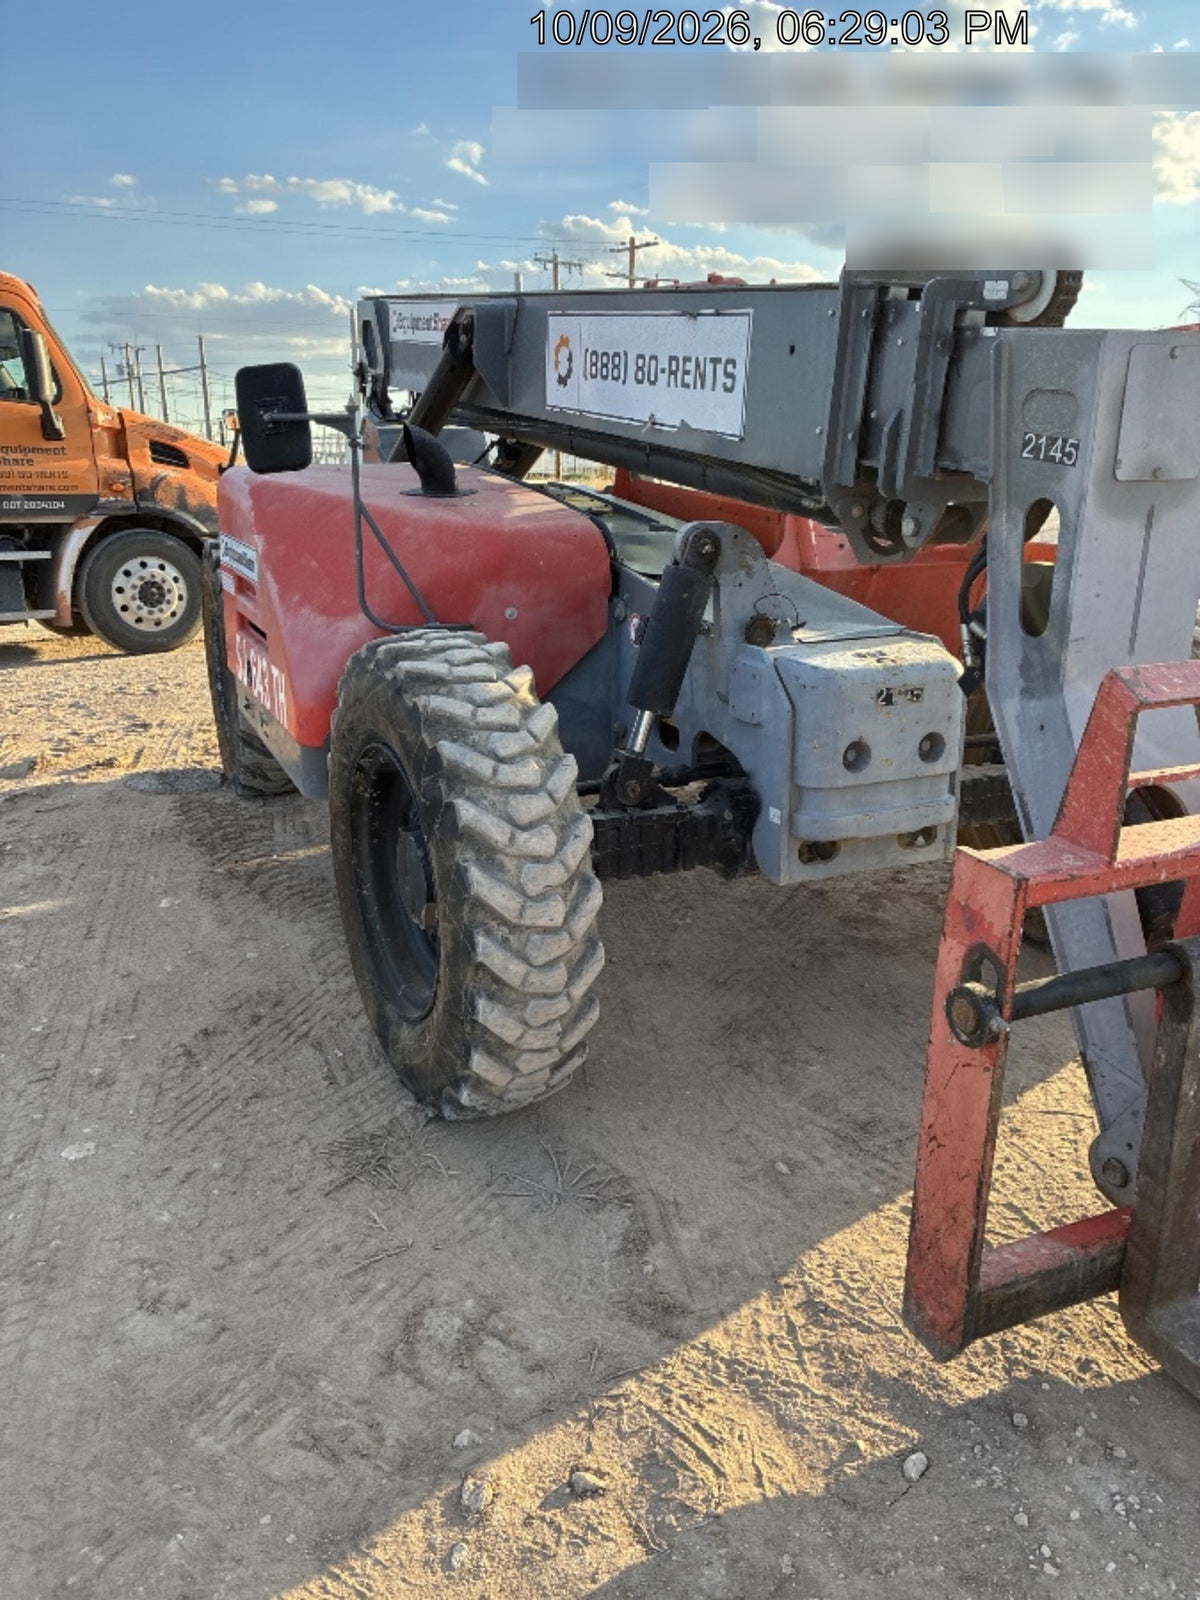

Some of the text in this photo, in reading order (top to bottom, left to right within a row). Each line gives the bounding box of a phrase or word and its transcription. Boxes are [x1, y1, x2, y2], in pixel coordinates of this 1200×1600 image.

[584, 348, 737, 394] (888) 80-RENTS
[0, 444, 67, 457] quipment
[0, 457, 34, 467] hare
[1021, 432, 1079, 465] 2145
[271, 664, 289, 730] TH
